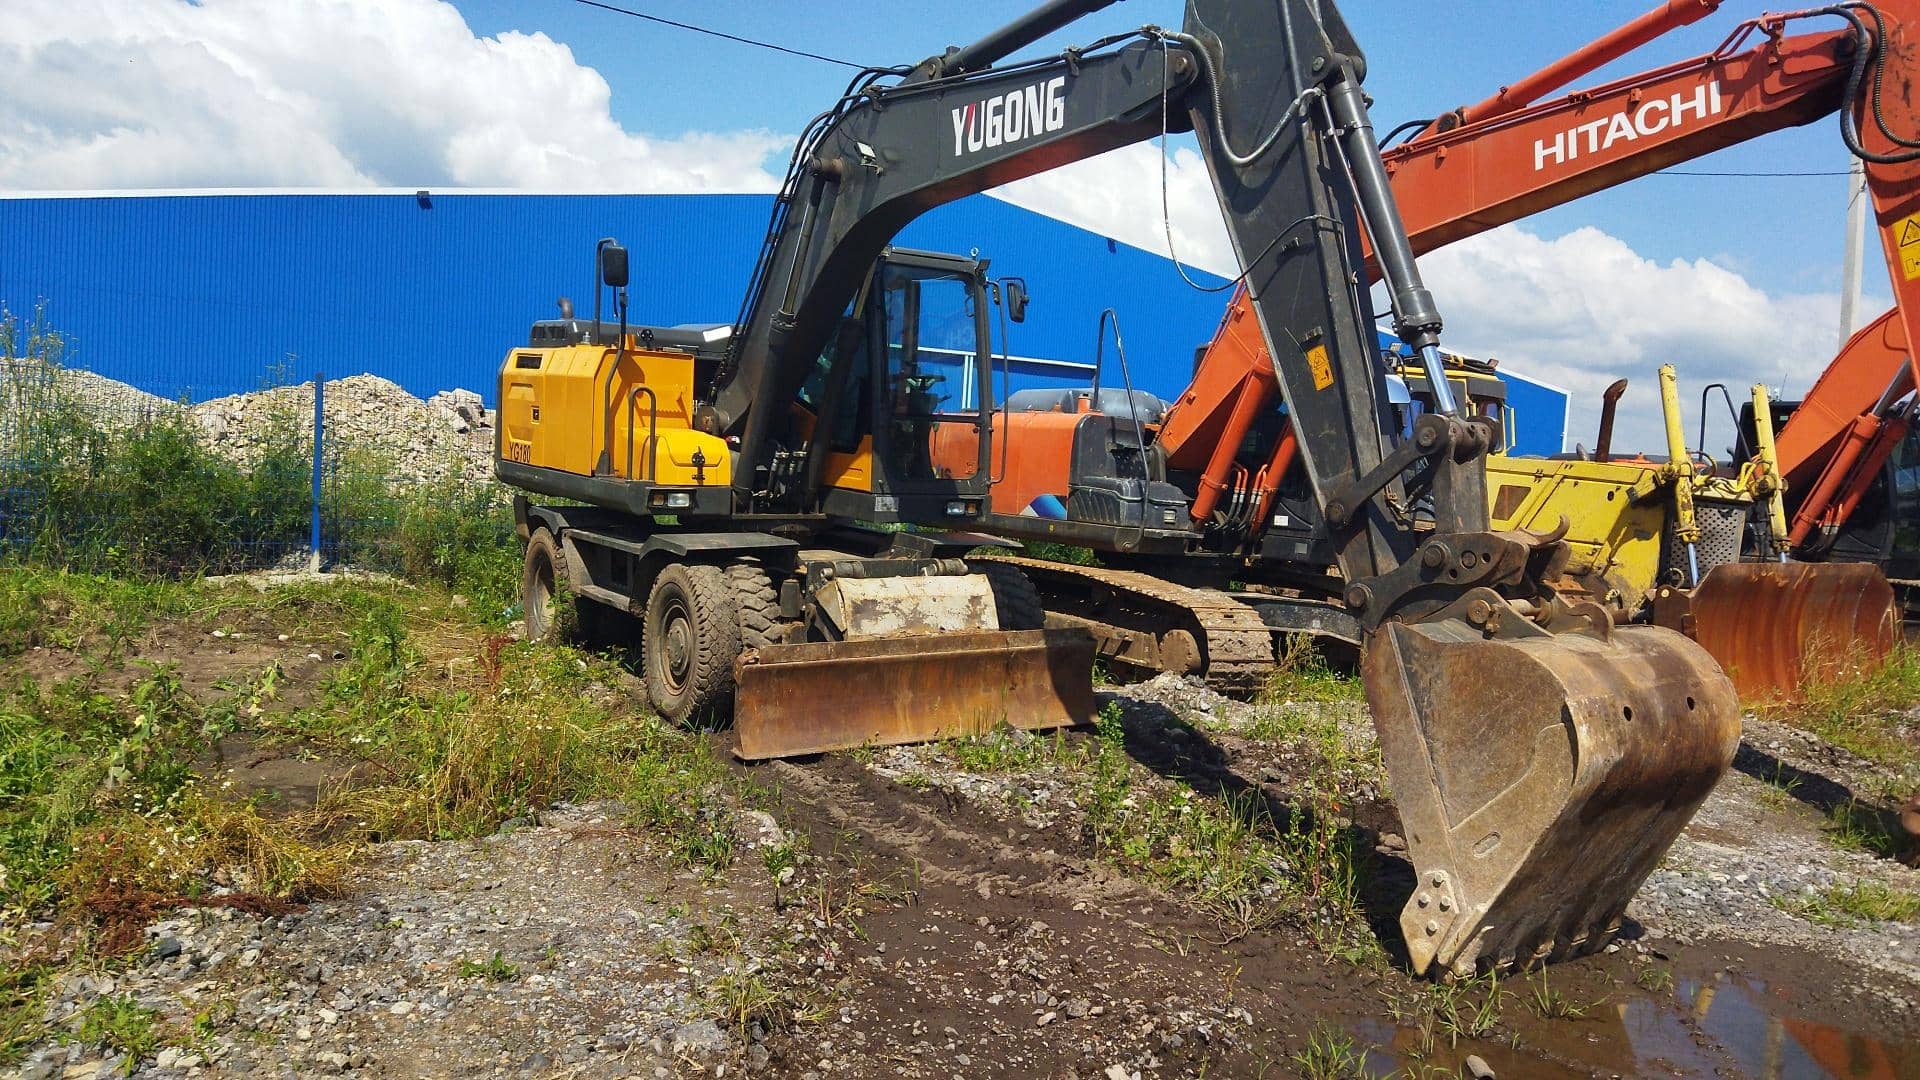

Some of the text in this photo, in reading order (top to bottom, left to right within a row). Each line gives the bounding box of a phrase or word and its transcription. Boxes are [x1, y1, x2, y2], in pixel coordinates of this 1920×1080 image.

[951, 75, 1065, 157] YUGONG
[1534, 79, 1722, 172] HITACHI
[509, 441, 531, 463] YG180
